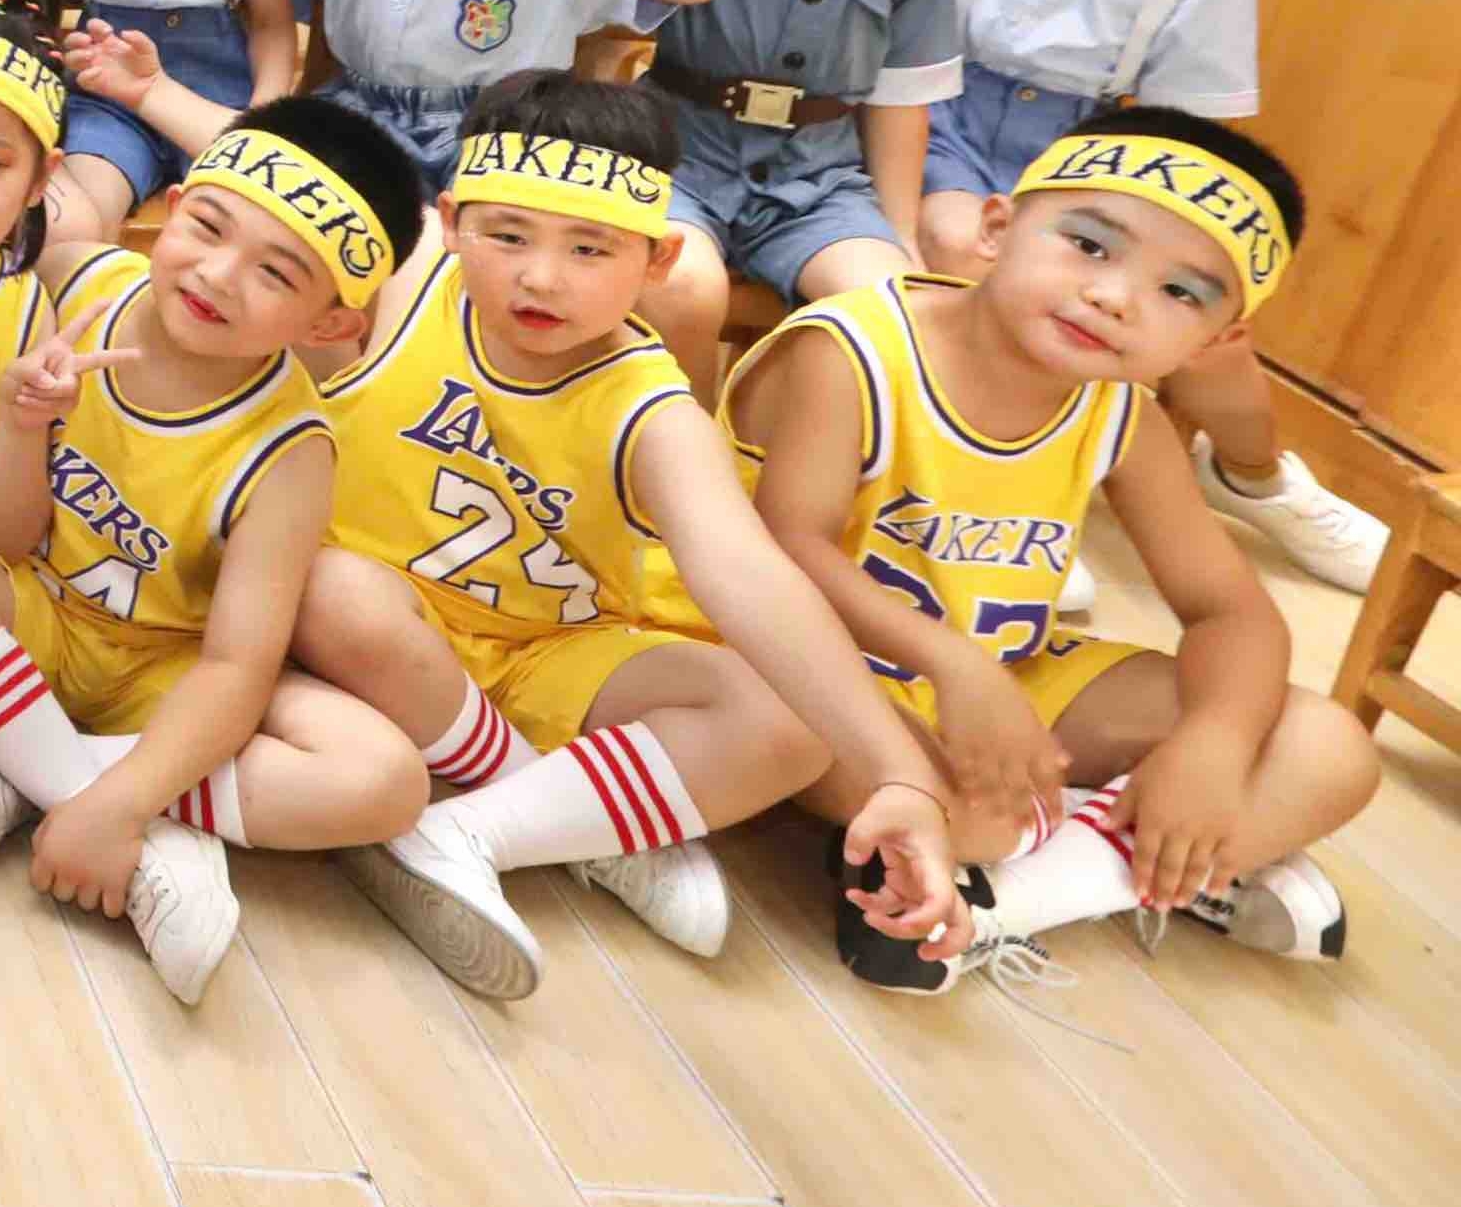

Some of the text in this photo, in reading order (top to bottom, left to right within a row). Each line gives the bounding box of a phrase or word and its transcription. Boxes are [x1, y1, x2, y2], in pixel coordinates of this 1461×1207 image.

[192, 134, 385, 279] LAKERS
[461, 132, 661, 204] LAKERS
[1044, 139, 1282, 284] LAKERS
